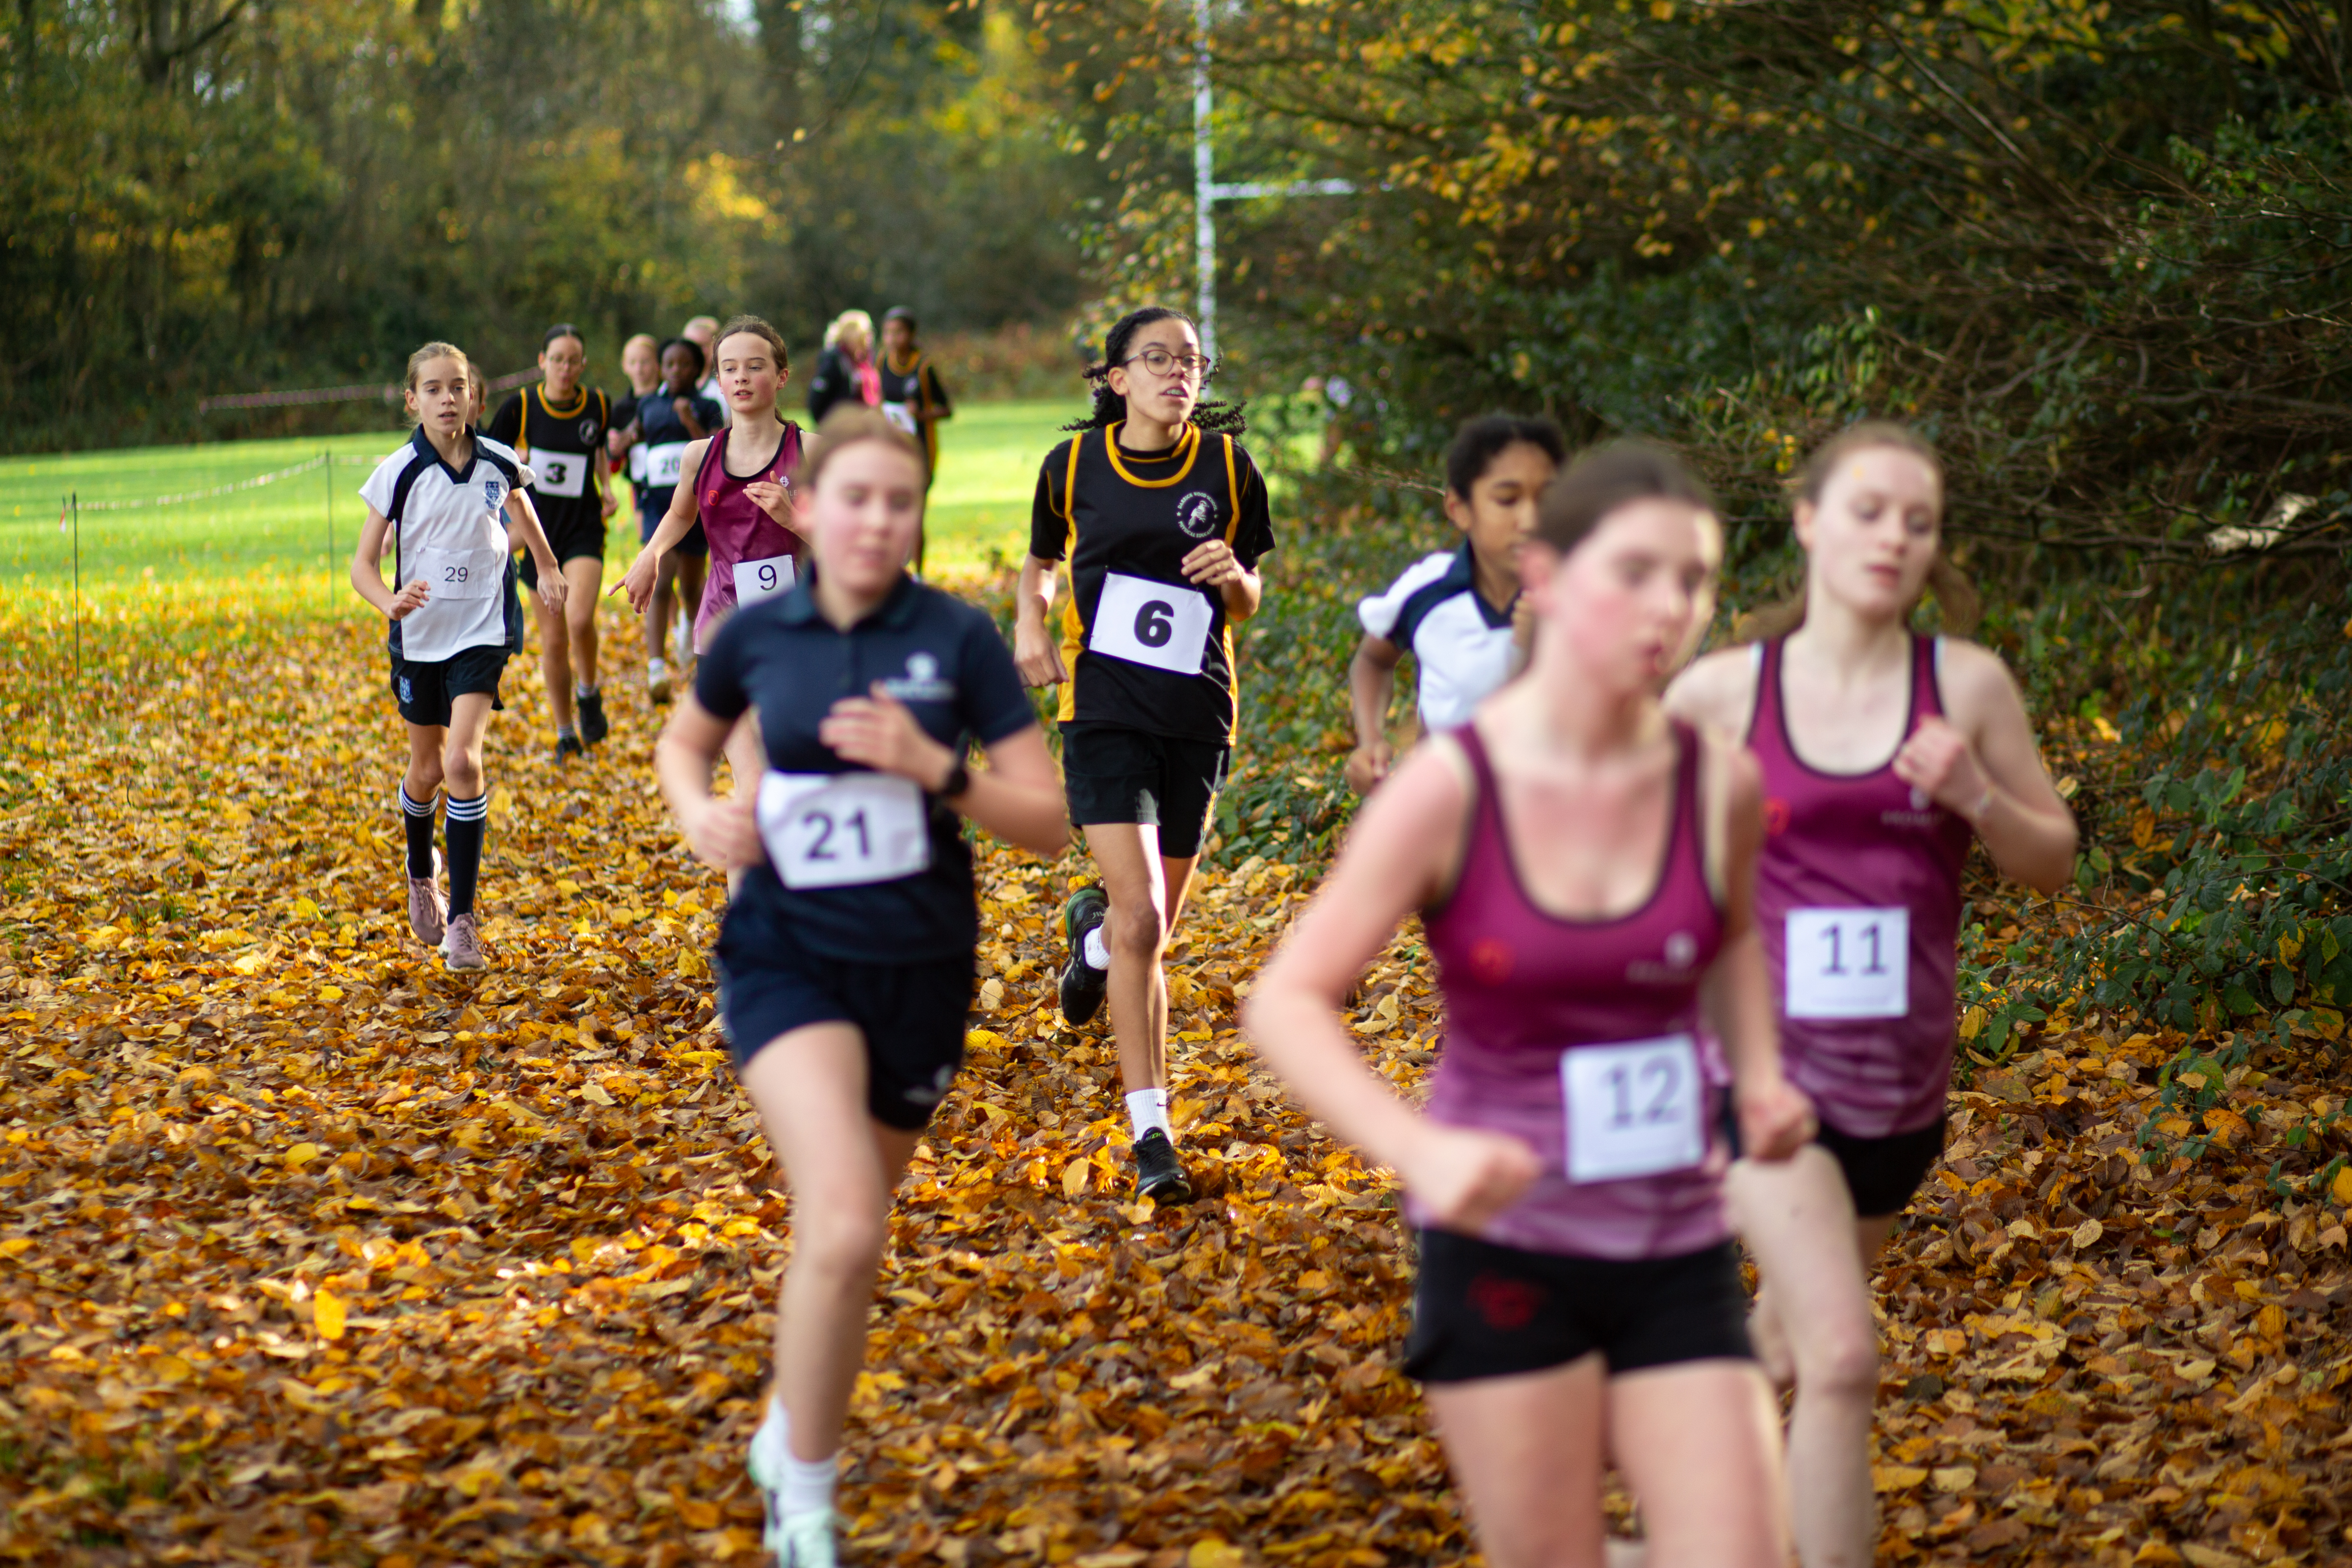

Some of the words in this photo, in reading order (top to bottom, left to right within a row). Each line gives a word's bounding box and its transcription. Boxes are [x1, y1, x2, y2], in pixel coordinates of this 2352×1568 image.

[544, 462, 567, 485] 3
[660, 457, 681, 475] 20
[1178, 493, 1193, 509] DARRICK
[1206, 495, 1217, 511] SCHOOL
[1178, 521, 1195, 537] PHYSICAL
[1196, 523, 1215, 538] EDUCATION
[445, 567, 468, 582] 29
[758, 565, 777, 591] 9
[1134, 600, 1174, 647] 6
[803, 808, 870, 860] 21
[1820, 924, 1887, 975] 11
[1602, 1058, 1681, 1129] 12
